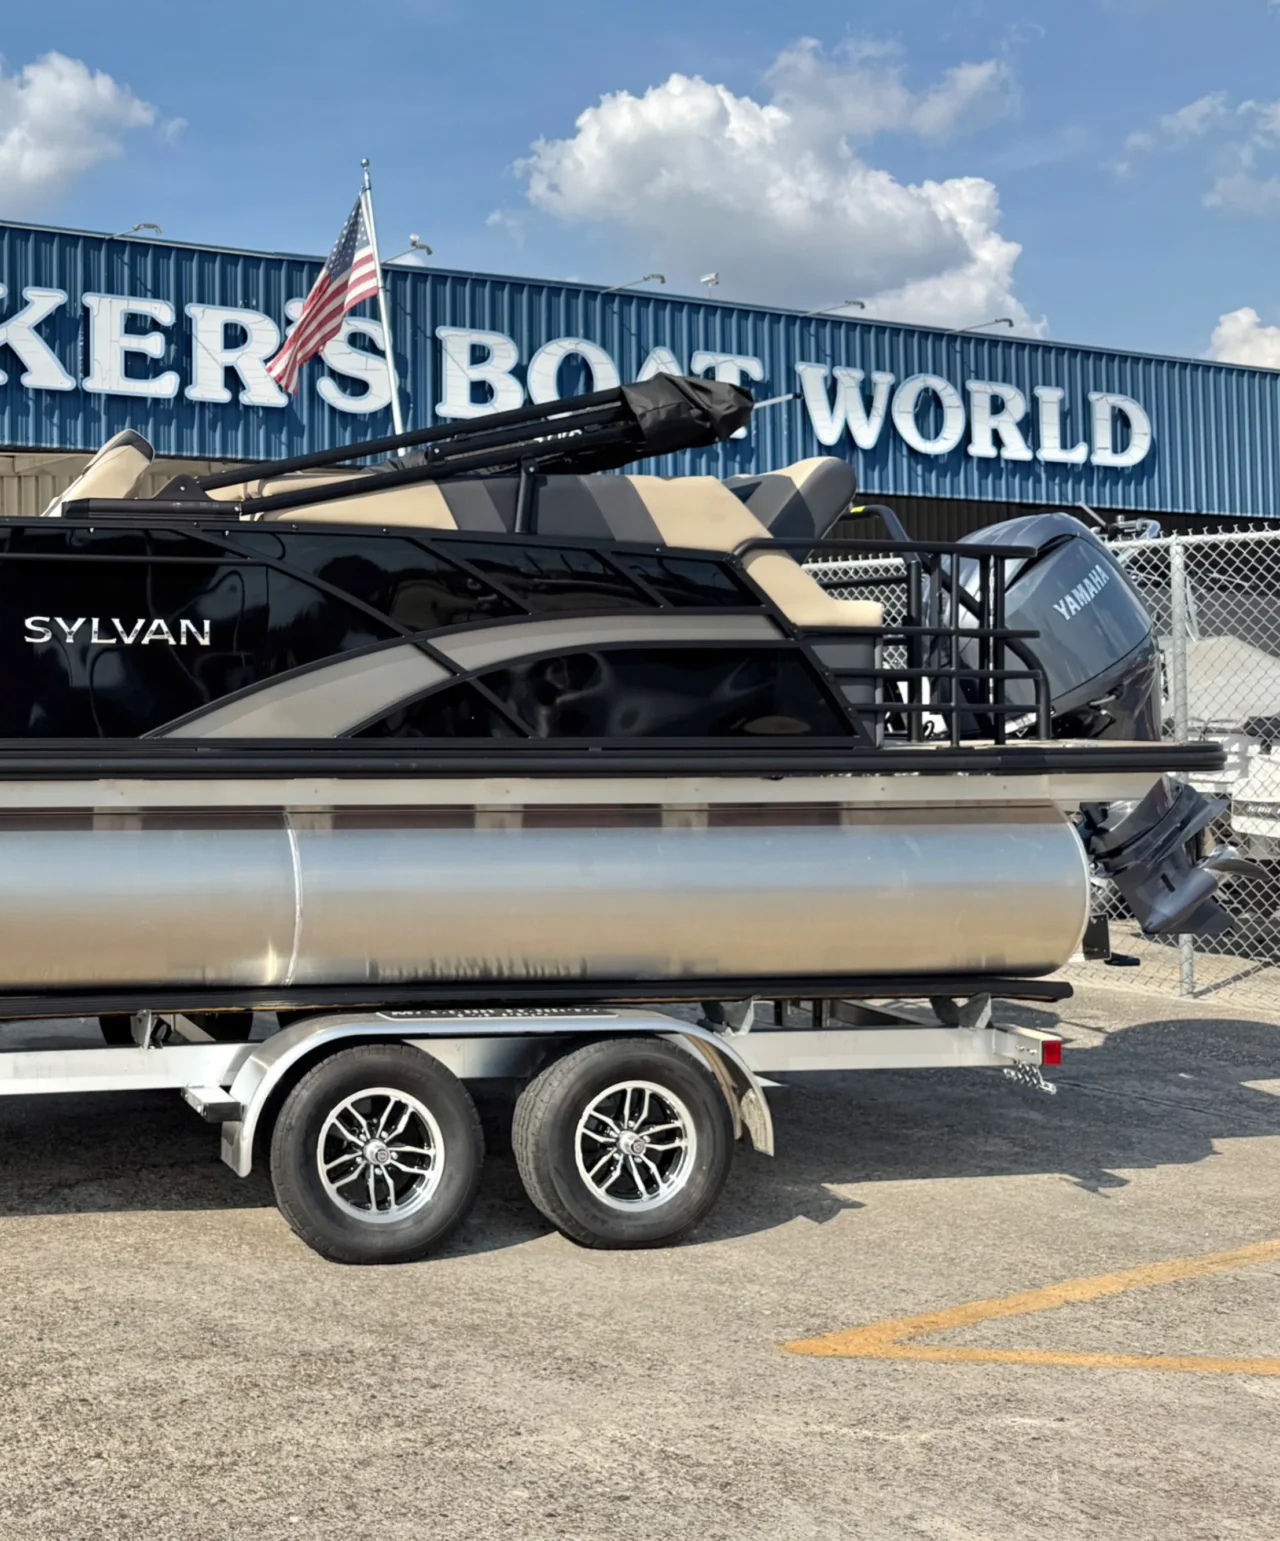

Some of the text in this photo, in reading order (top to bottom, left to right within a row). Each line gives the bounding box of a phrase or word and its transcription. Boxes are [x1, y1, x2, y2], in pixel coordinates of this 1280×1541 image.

[794, 361, 1152, 467] WORLD
[1052, 564, 1110, 620] YAMAHA
[24, 615, 211, 646] SYLVAN
